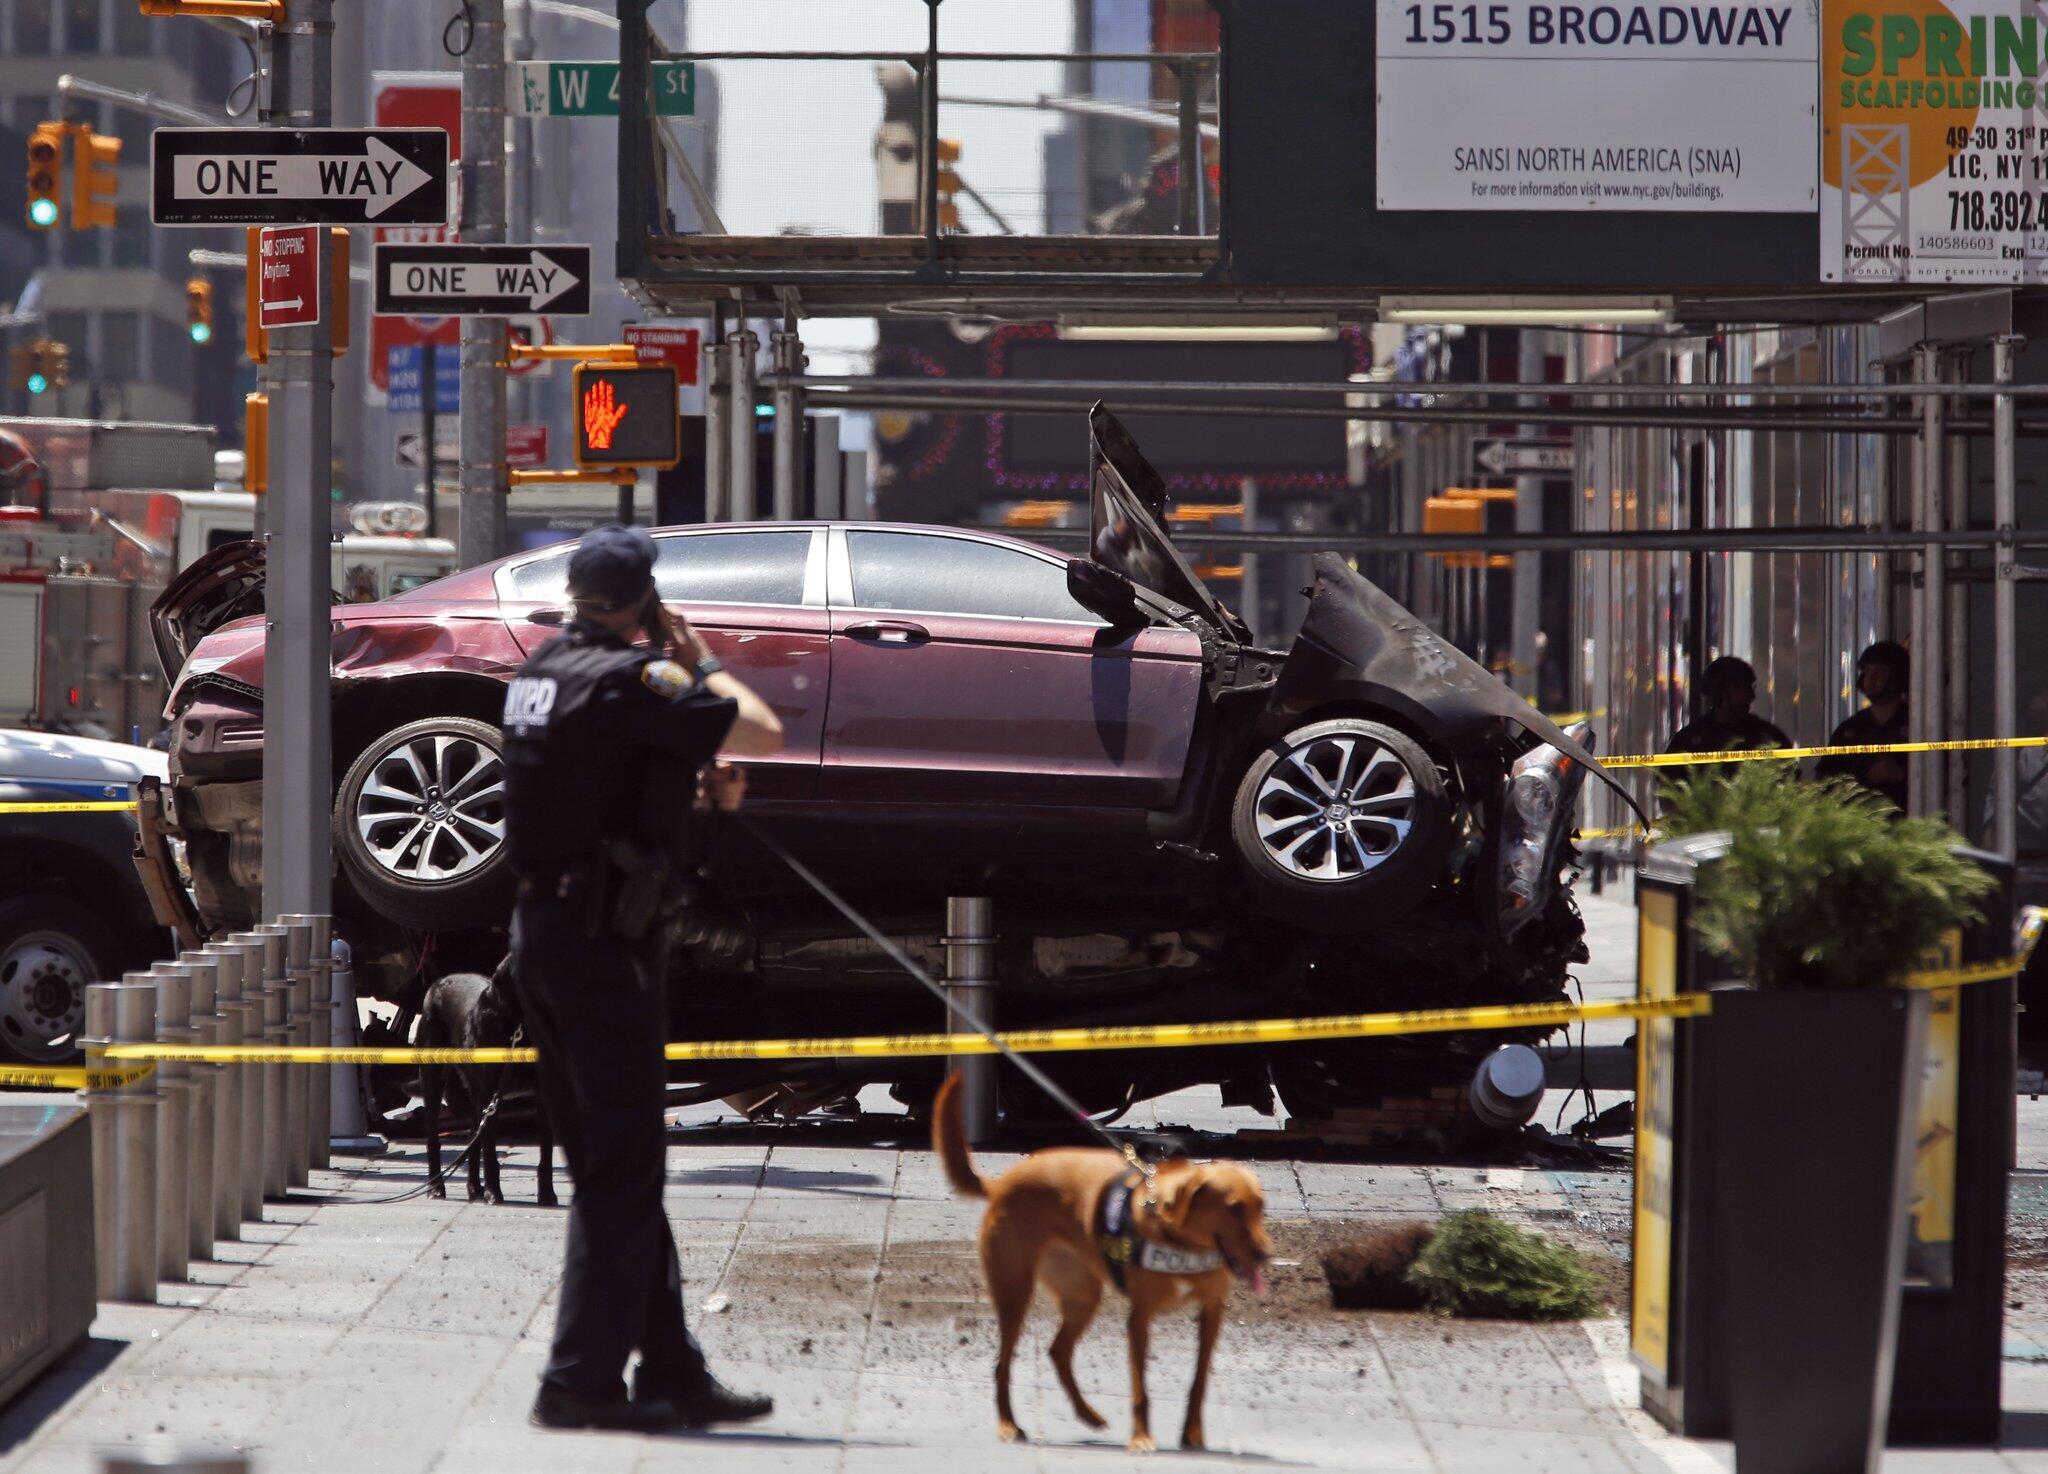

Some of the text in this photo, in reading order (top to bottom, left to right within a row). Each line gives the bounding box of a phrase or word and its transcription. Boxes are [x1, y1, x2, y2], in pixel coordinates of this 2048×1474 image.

[1405, 5, 1792, 46] 1515 BROADWAY
[1841, 14, 2048, 77] SPRIN
[558, 70, 589, 109] W
[666, 69, 688, 94] St
[1840, 79, 2036, 109] SCAFFOLDING
[1946, 126, 1998, 150] 49-30
[2005, 126, 2036, 150] 31st
[1454, 147, 1741, 178] SANSI NORTH AMERICA (SNA)
[1948, 154, 1988, 181] LIC,
[1997, 155, 2022, 179] NY
[197, 160, 403, 195] ONE WAY
[1472, 181, 1724, 201] For more information visit www.nyc.gov/buildings.
[1948, 190, 2048, 232] 718.392.4
[263, 236, 305, 257] NO STOPPING
[1844, 244, 1889, 259] Permit
[1893, 244, 1914, 259] No.
[1918, 236, 1995, 251] 140586603
[2002, 245, 2029, 261] Exp.
[263, 261, 291, 282] Anytime
[406, 267, 558, 293] ONE WAY
[1844, 268, 1894, 276] STORAGE
[1918, 268, 1938, 276] NOT
[1945, 268, 2009, 276] PERMITTED
[626, 331, 689, 345] NO STANDING
[504, 676, 558, 716] NYPD
